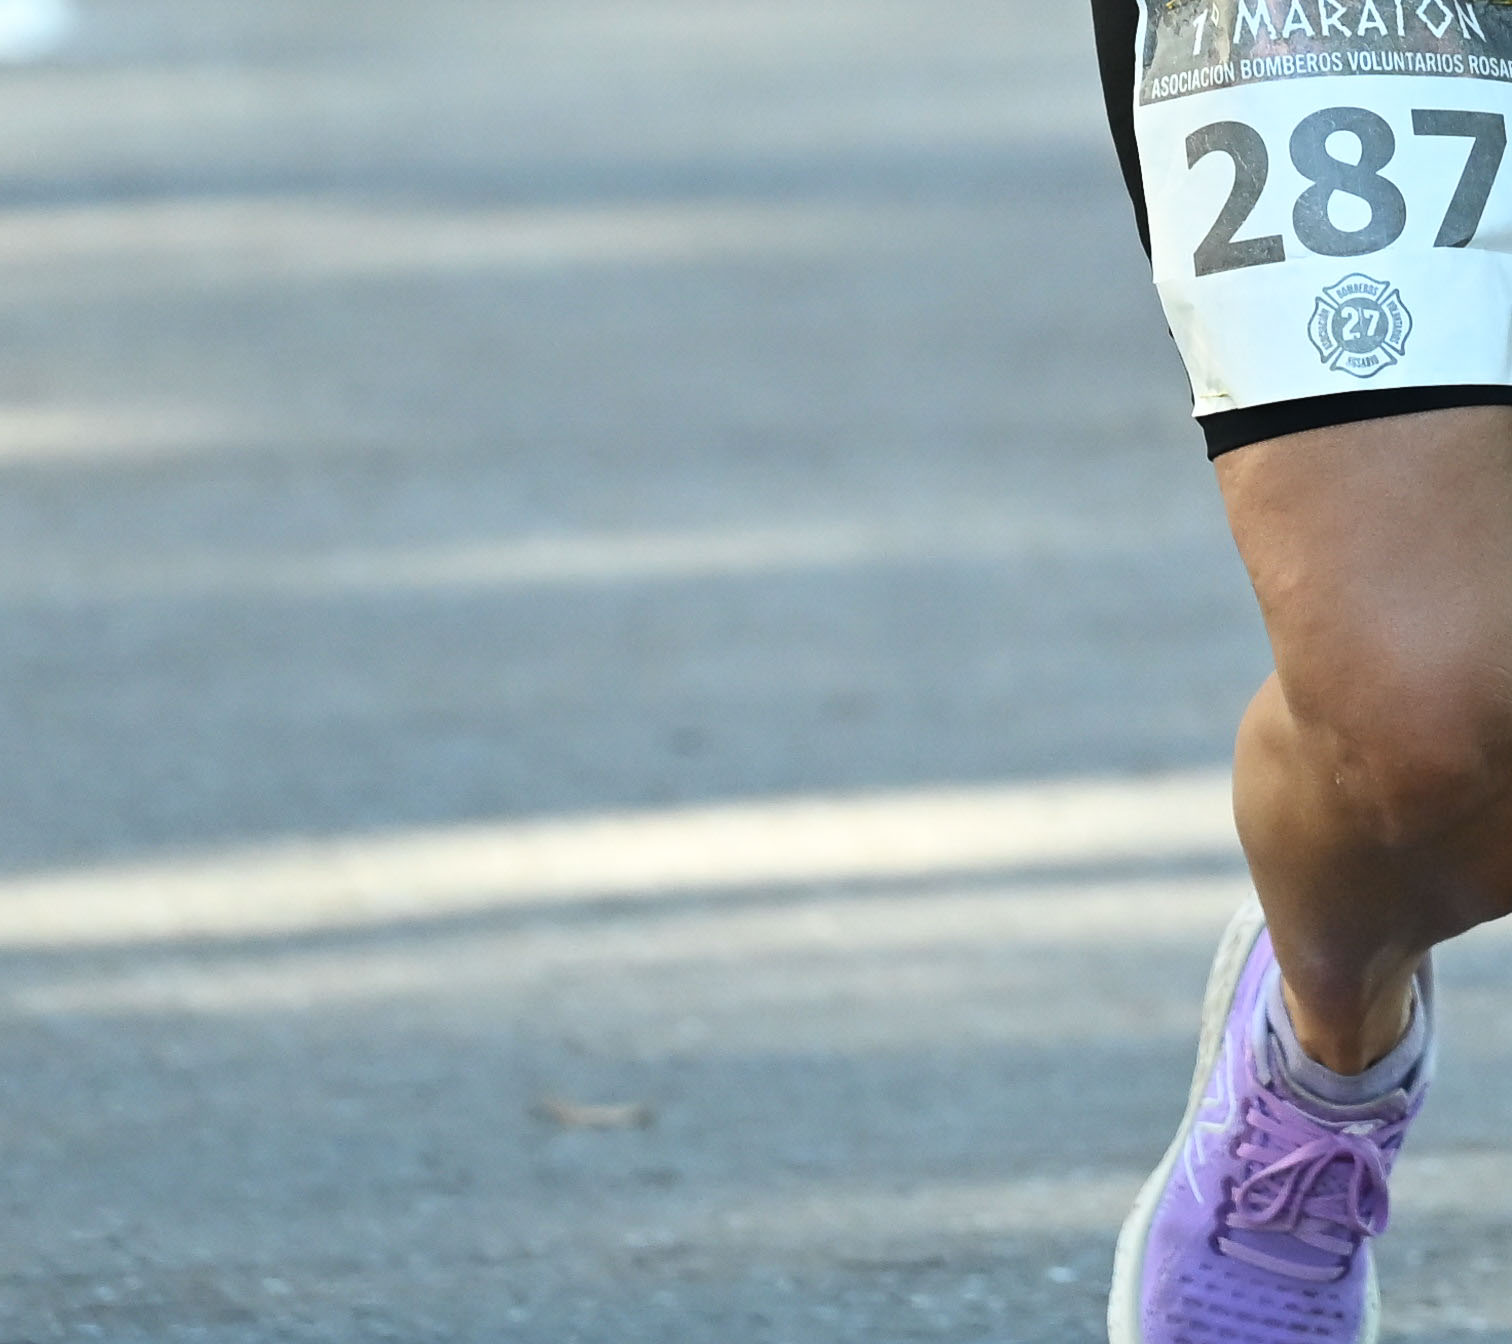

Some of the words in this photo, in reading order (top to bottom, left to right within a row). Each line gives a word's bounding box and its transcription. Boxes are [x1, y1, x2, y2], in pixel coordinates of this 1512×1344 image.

[1240, 52, 1343, 81] BOMBEROS
[1347, 50, 1465, 74] VOLUNTARIOS
[1185, 106, 1508, 278] 287
[1340, 306, 1381, 341] 27
